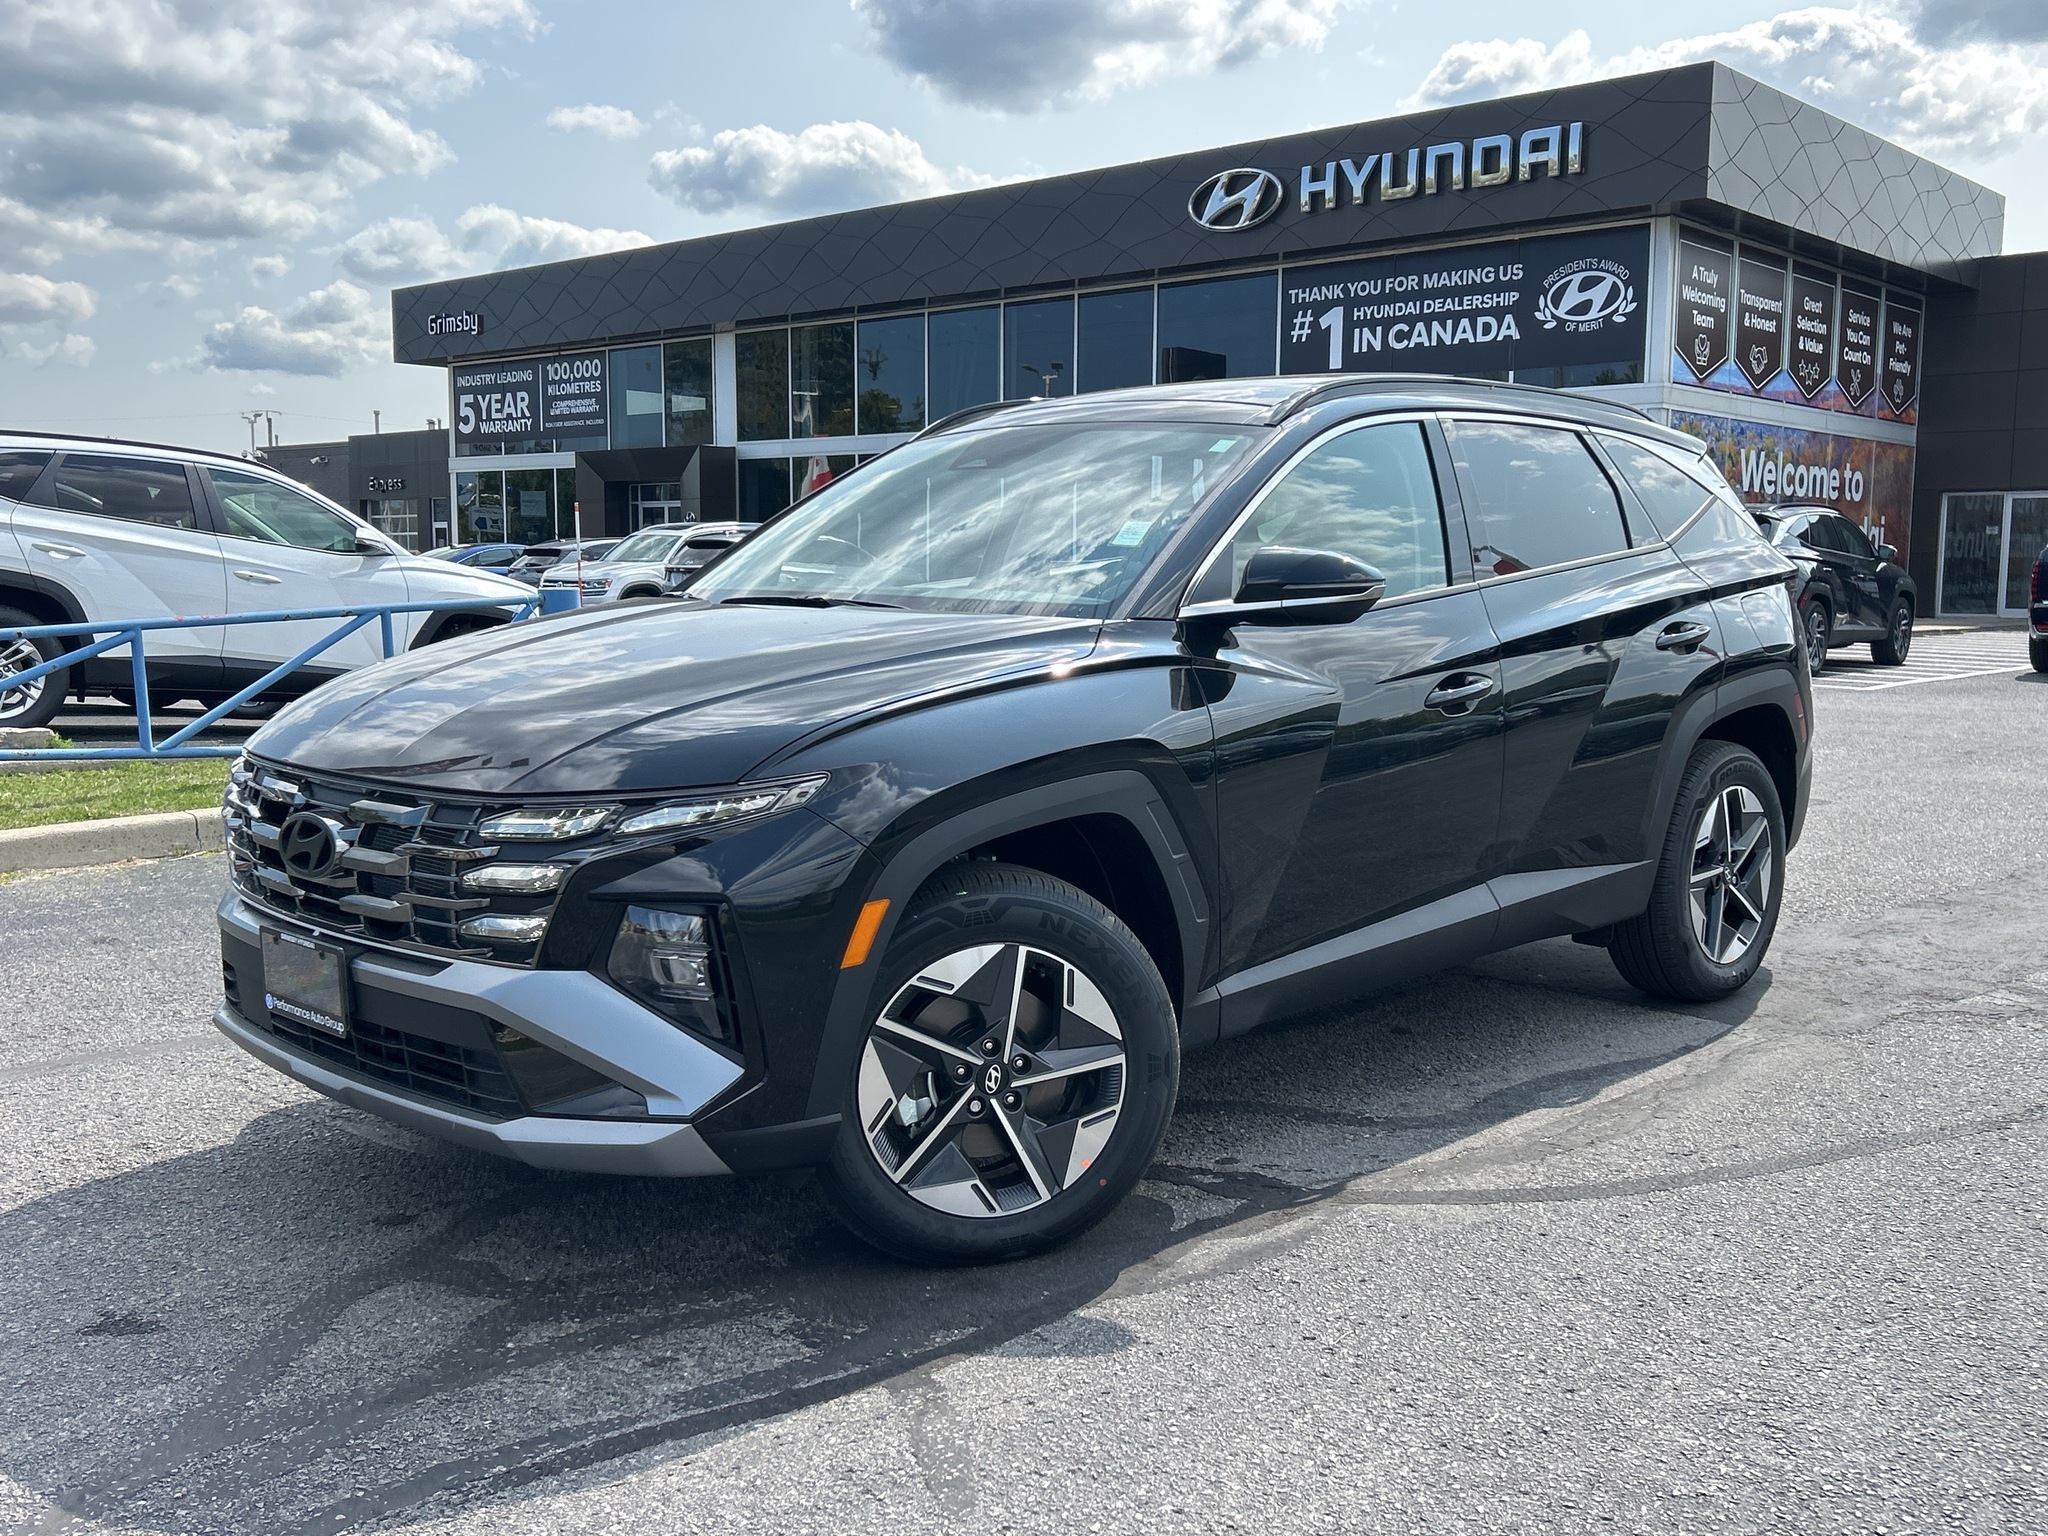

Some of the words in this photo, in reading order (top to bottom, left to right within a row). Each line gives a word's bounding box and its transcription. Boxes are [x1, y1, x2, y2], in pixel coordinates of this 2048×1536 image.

[1300, 121, 1583, 213] HYUNDAI
[1289, 283, 1344, 304] THANK
[1347, 279, 1382, 297] YOU
[1385, 276, 1419, 293] FOR
[1423, 266, 1495, 289] MAKING
[1499, 263, 1524, 281] US
[1543, 258, 1598, 289] PRESIDENT'S
[1599, 259, 1630, 281] AWARD
[1692, 265, 1698, 280] A
[1699, 266, 1718, 288] Truly
[1353, 300, 1420, 321] HYUNDAI
[1423, 291, 1520, 314] DEALERSHIP
[1682, 284, 1726, 313] Welcoming
[1740, 288, 1782, 314] Transparent
[1803, 296, 1822, 314] Great
[427, 310, 478, 335] Grimsby
[1565, 322, 1577, 332] OF
[1579, 318, 1604, 332] MERIT
[1692, 310, 1715, 329] Team
[1744, 311, 1750, 327] &
[1751, 313, 1777, 333] Honest
[1796, 315, 1827, 335] Selection
[1848, 309, 1871, 327] Service
[1353, 326, 1382, 353] IN
[1387, 314, 1521, 350] CANADA
[1847, 328, 1858, 343] You
[1859, 331, 1871, 346] Can
[1892, 321, 1902, 335] We
[1902, 324, 1912, 338] Are
[1798, 336, 1805, 350] &
[1805, 337, 1824, 354] Value
[1843, 347, 1862, 363] Count
[1862, 351, 1871, 365] On
[547, 359, 601, 382] 100,000
[1889, 358, 1911, 376] Friendly
[457, 372, 496, 388] INDUSTRY
[497, 369, 533, 384] LEADING
[548, 380, 601, 396] KILOMETRES
[458, 394, 476, 434] 5
[477, 391, 530, 420] YEAR
[570, 405, 600, 414] WARRANTY
[479, 418, 533, 434] WARRANTY
[1741, 449, 1840, 500] Welcome
[1844, 463, 1864, 502] to
[272, 997, 311, 1020] Performance
[310, 1011, 324, 1025] Auto
[324, 1016, 345, 1034] Group
